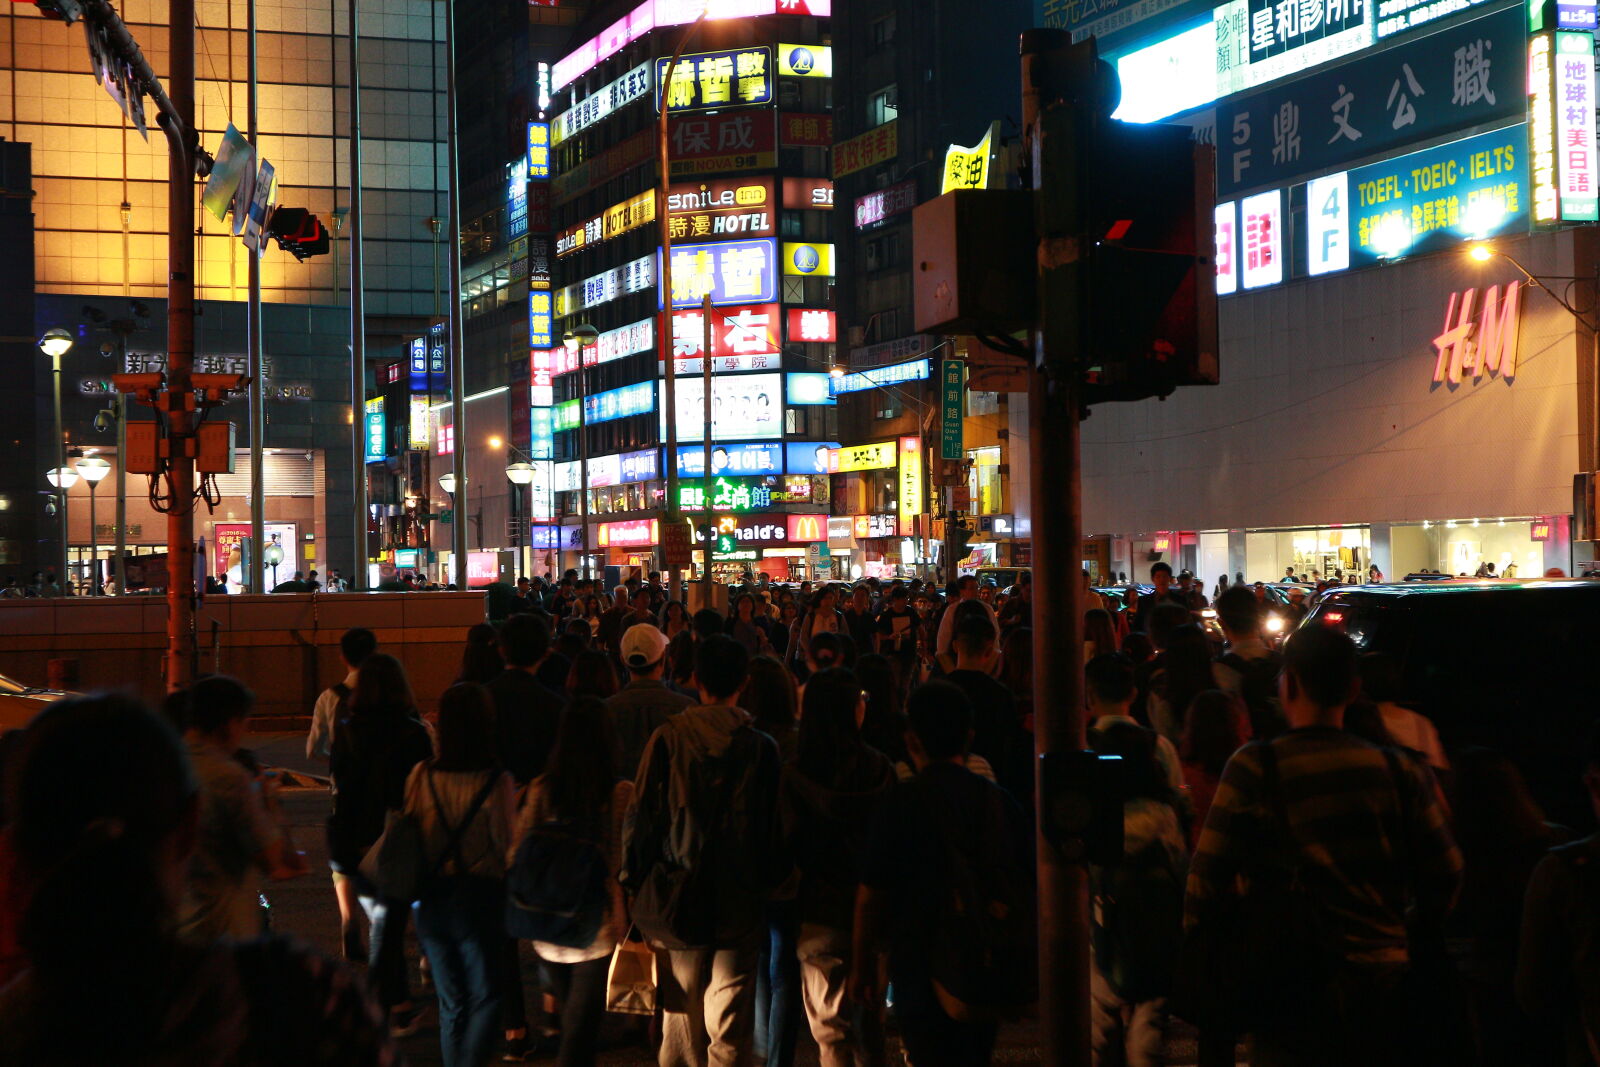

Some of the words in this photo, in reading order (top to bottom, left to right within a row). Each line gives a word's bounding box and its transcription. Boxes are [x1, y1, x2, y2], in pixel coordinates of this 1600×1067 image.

[1216, 18, 1231, 72] 珍顏
[1232, 8, 1248, 66] 唯上
[610, 67, 646, 109] 非凡英文
[737, 52, 766, 101] 數學
[1272, 38, 1496, 166] 鼎文公職
[672, 117, 755, 154] 保成
[1232, 112, 1251, 183] 5F
[1565, 61, 1589, 192] 地球村美日語
[696, 158, 733, 171] NOVA
[1358, 175, 1402, 206] TOEFL
[1411, 160, 1456, 193] TOEIC
[1469, 145, 1515, 180] IELTS
[606, 207, 631, 233] HOTEL
[669, 216, 711, 237] 詩漫
[713, 214, 769, 233] HOTEL
[1321, 186, 1340, 263] 4F
[1411, 195, 1459, 234] 全民英檢
[671, 247, 764, 300] 赫哲
[1432, 280, 1519, 384] H&M
[128, 352, 273, 380] 新光越百貨
[947, 373, 958, 419] 館前路
